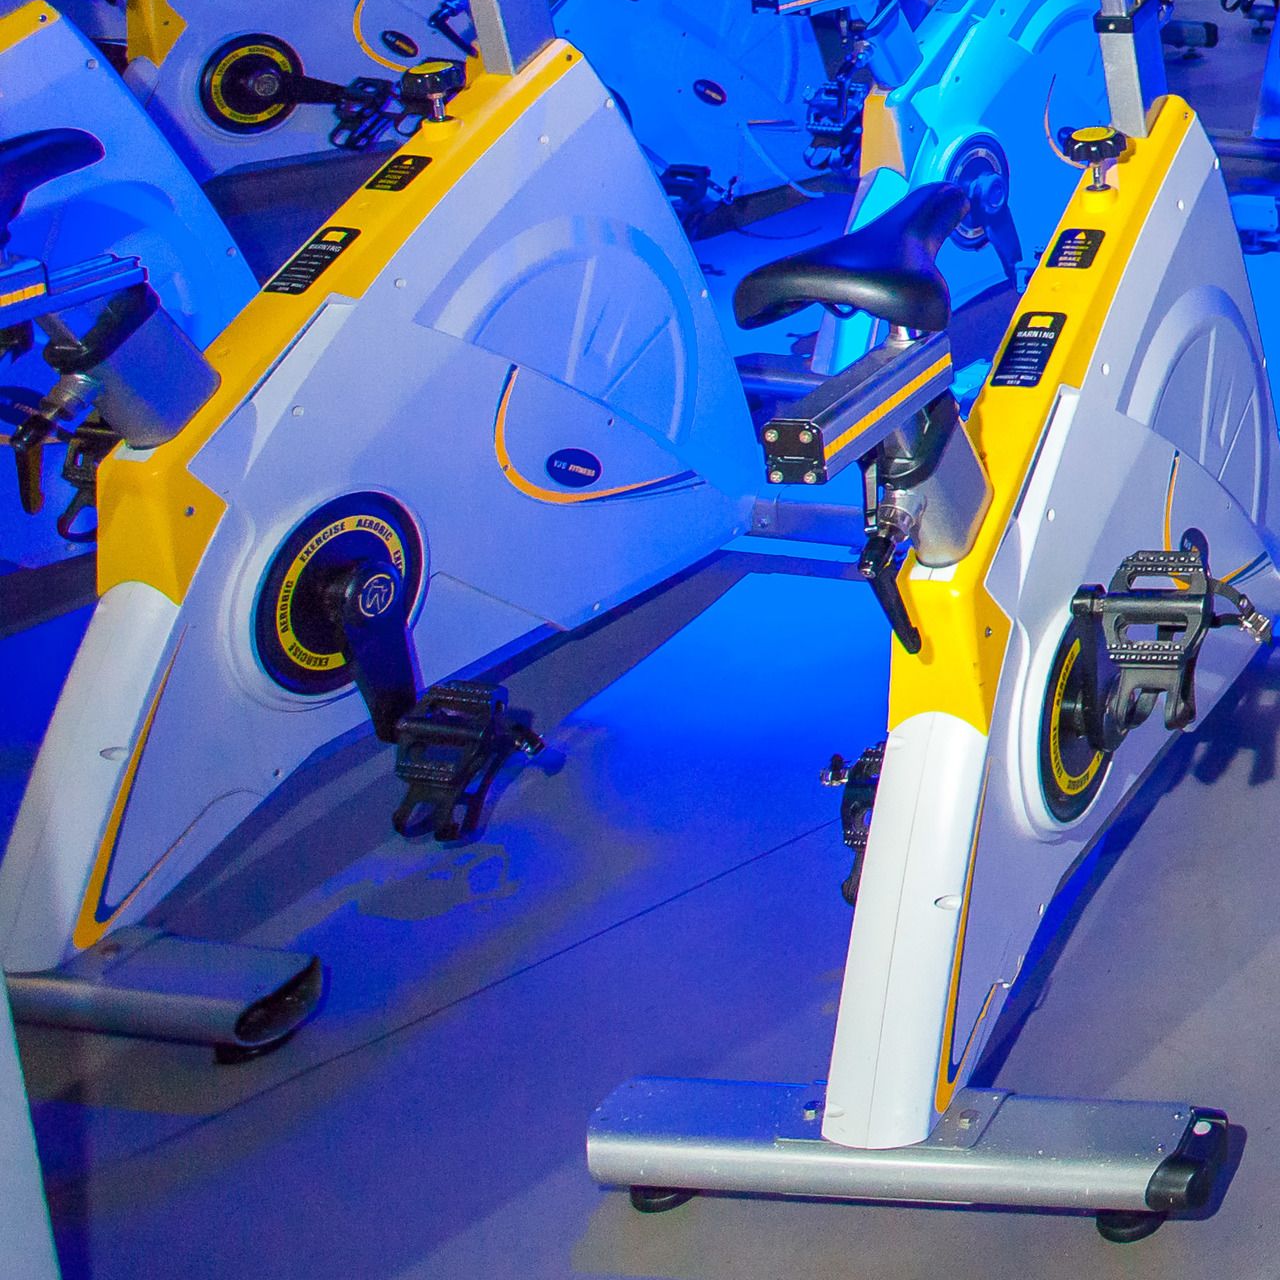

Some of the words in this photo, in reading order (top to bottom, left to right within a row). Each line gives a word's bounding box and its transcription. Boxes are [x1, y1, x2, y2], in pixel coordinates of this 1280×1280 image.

[1016, 330, 1055, 339] WARNING
[280, 580, 293, 633] AEROBIC
[300, 522, 345, 563] EXERCISE
[356, 518, 393, 542] AEROBIC
